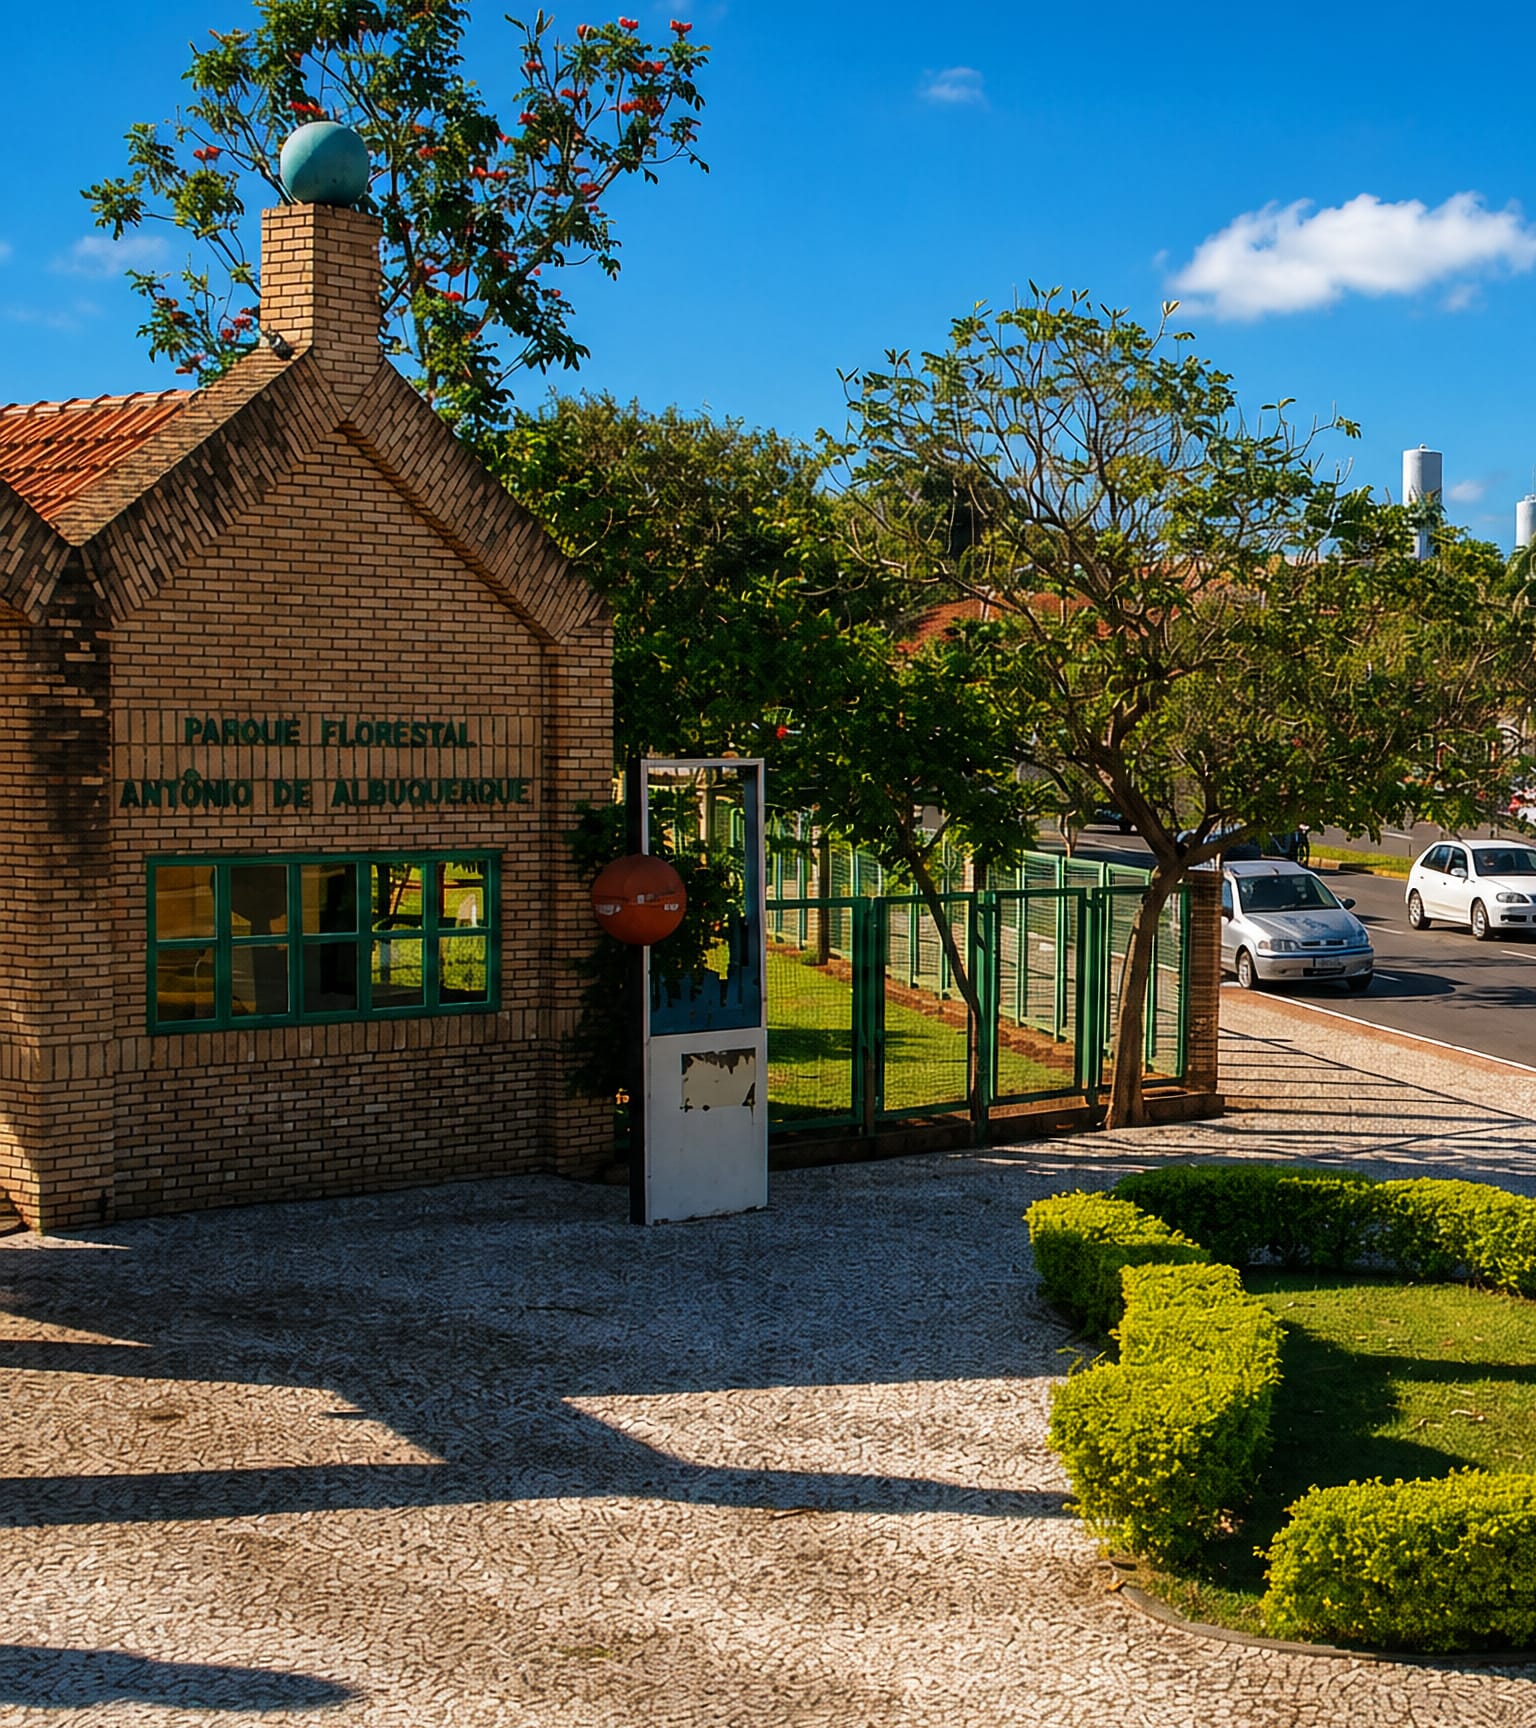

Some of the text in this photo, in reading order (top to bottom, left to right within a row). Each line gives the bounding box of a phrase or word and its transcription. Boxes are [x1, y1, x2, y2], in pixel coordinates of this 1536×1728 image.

[185, 717, 477, 747] PARQUE FLORESTAL
[120, 768, 534, 808] ANTÔNIO DE ALBUQUERQUE
